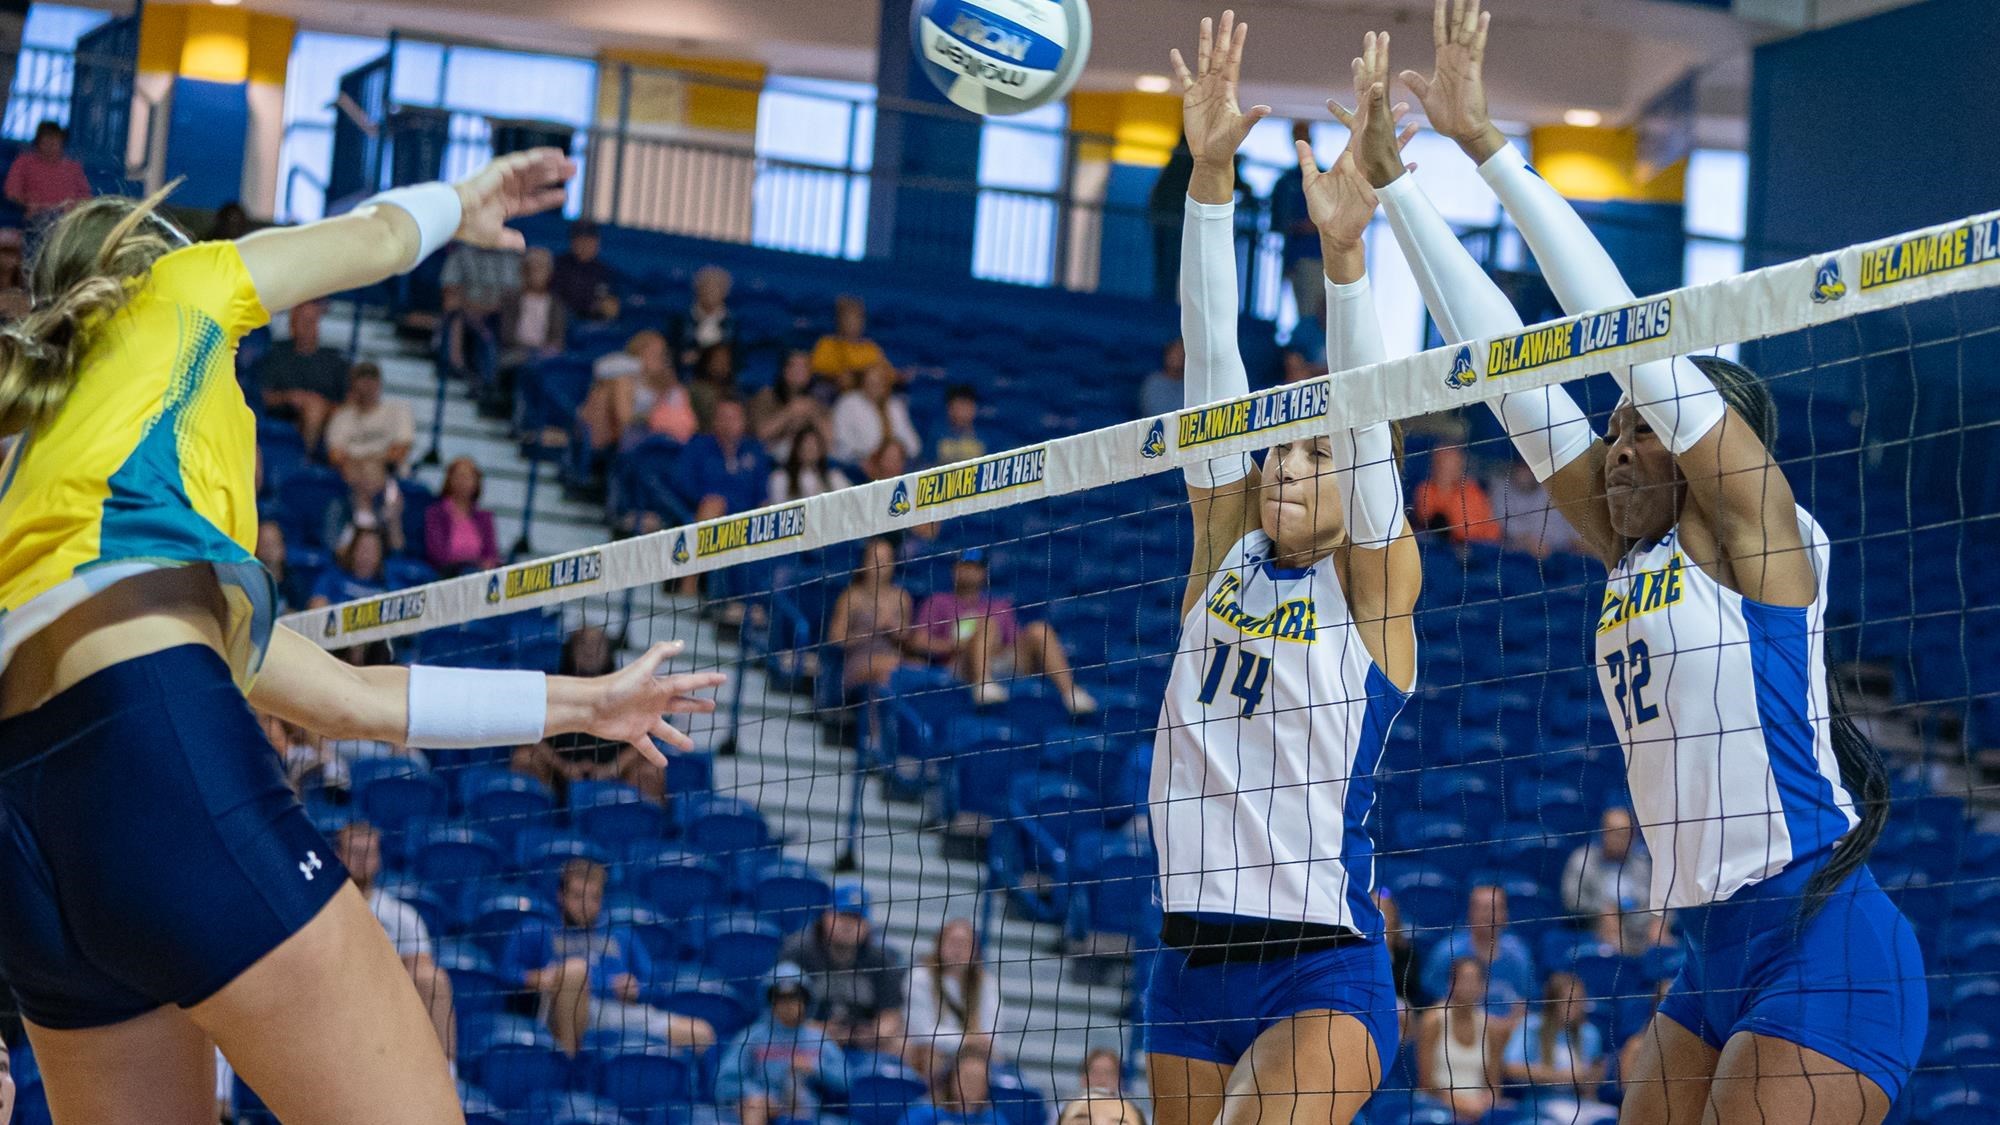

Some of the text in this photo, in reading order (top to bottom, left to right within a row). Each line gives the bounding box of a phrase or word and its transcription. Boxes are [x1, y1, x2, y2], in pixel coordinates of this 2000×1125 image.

[935, 35, 1027, 87] molten
[1861, 218, 2000, 288] DELAWARE BL
[1487, 323, 1574, 376] DELAWARE
[1626, 299, 1671, 343] HENS
[1179, 384, 1330, 447] DELAWARE BLUE HENS
[917, 450, 1045, 506] DELAWARE BLUE HENS
[1197, 637, 1272, 721] 14
[1603, 638, 1660, 731] 22
